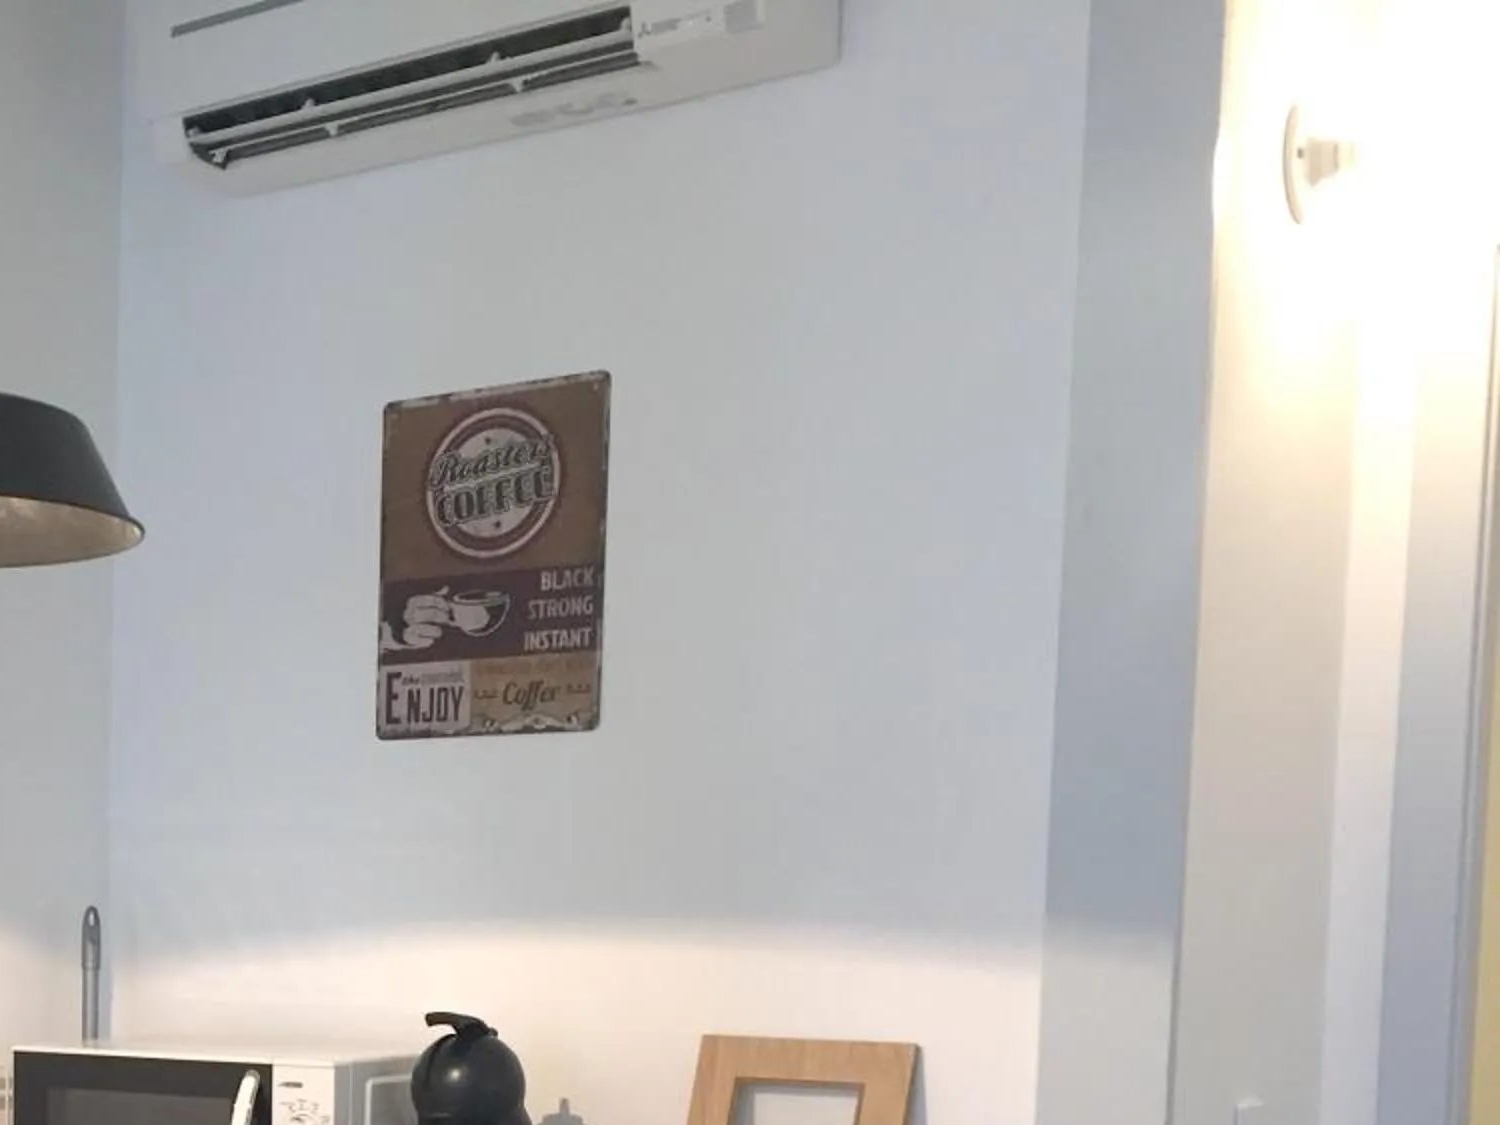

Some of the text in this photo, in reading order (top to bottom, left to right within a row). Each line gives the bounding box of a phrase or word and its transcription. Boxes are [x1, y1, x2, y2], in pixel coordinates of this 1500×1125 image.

[541, 567, 595, 591] BLACK
[528, 598, 594, 620] STRONG
[524, 627, 593, 651] INSTANT
[385, 672, 465, 725] ENJOY
